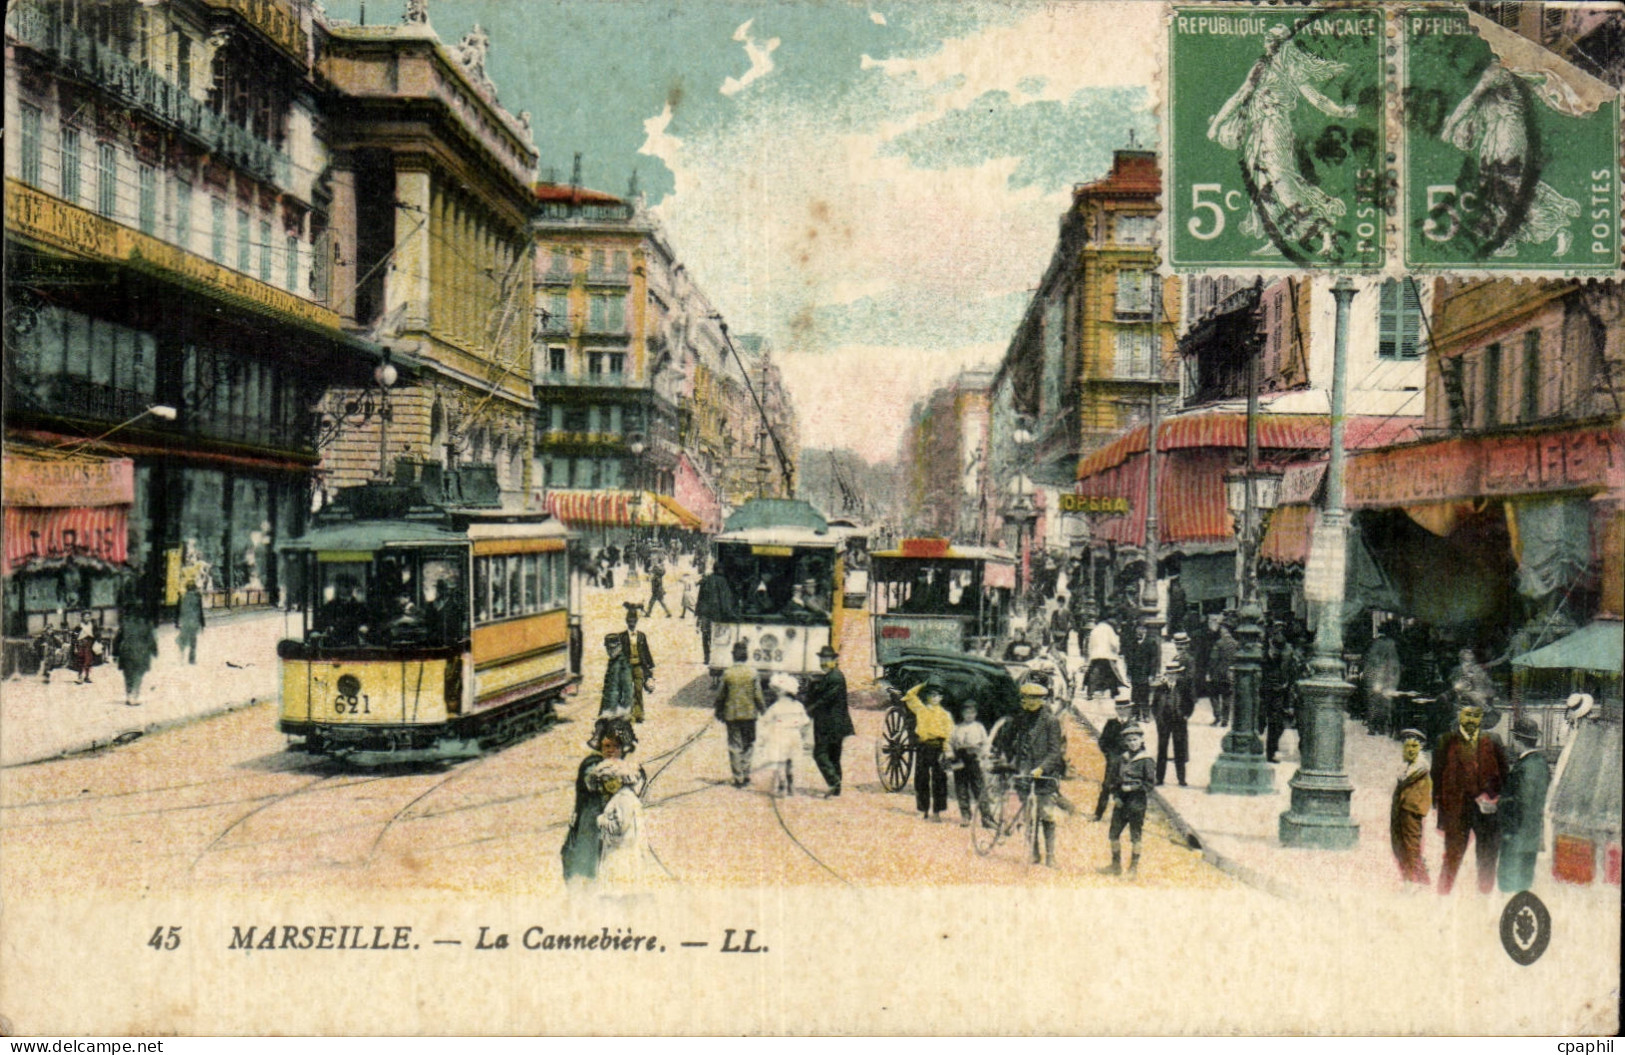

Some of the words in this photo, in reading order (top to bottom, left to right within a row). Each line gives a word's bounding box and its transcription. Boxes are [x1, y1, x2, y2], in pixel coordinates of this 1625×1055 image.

[1178, 17, 1266, 37] REPUBLIQUE
[1356, 168, 1376, 253] POSTES
[1591, 168, 1611, 253] POSTES
[1064, 495, 1130, 512] OPERA
[752, 648, 784, 663] 638
[334, 693, 371, 715] 621
